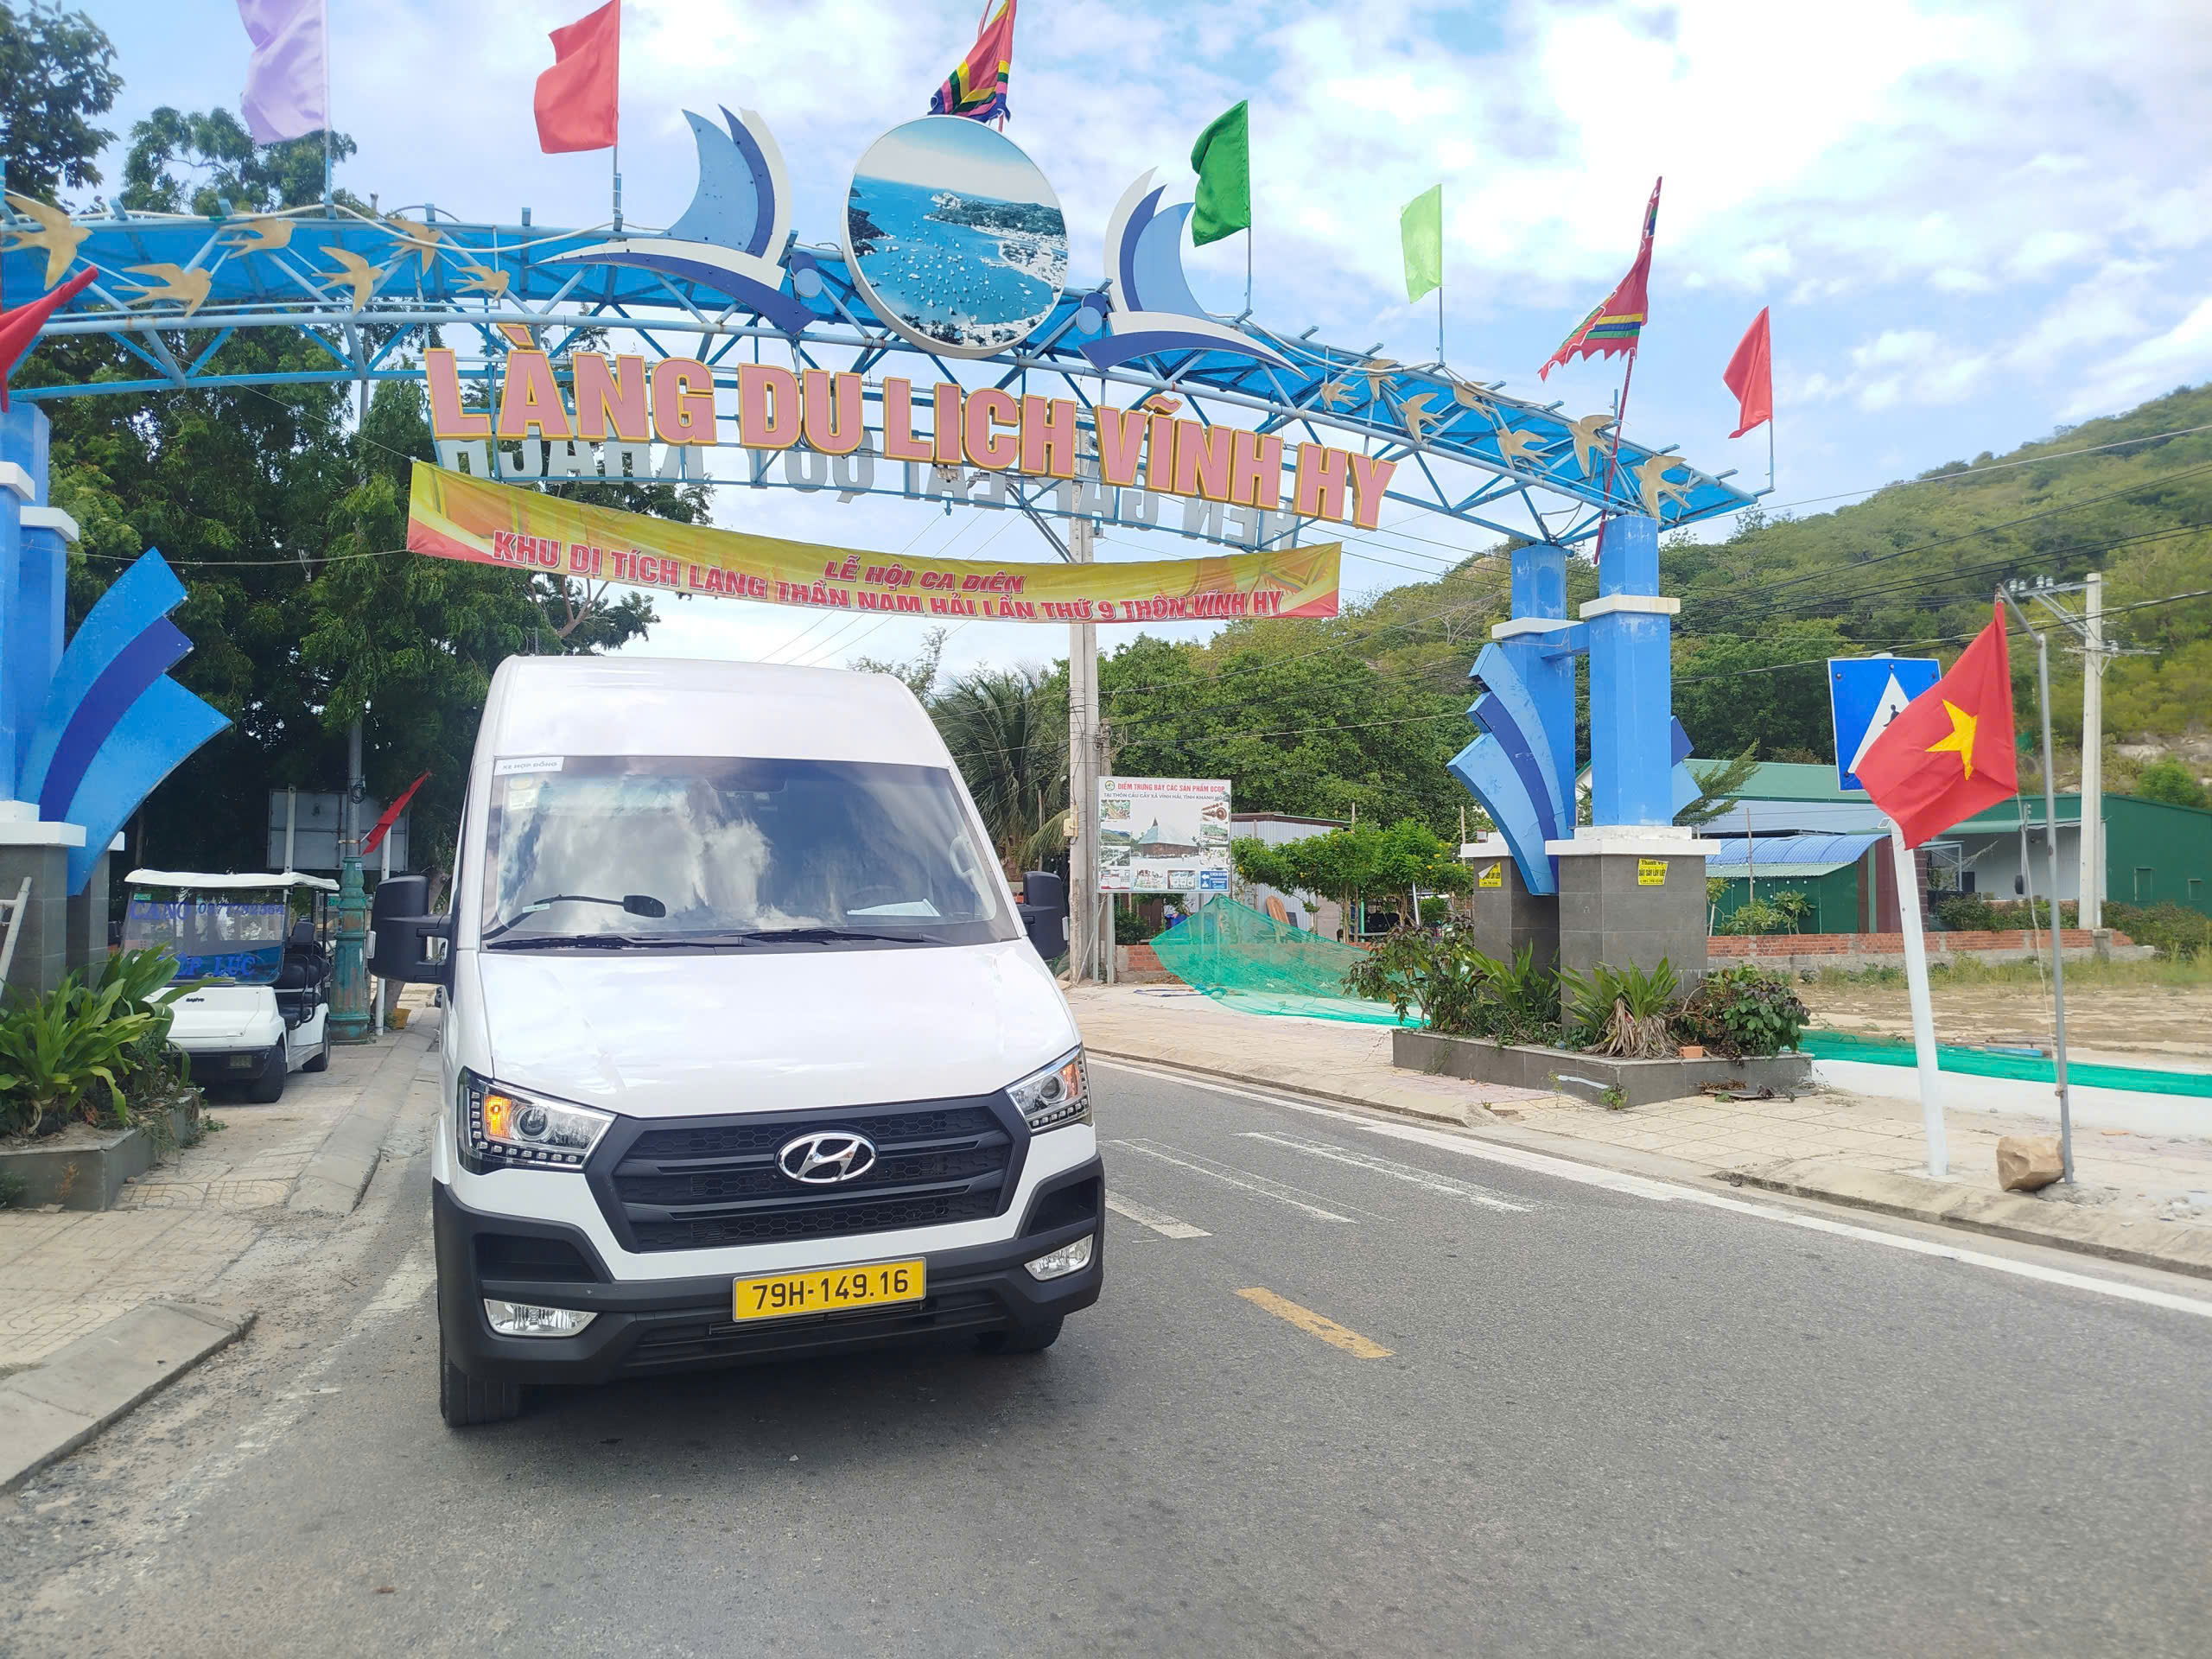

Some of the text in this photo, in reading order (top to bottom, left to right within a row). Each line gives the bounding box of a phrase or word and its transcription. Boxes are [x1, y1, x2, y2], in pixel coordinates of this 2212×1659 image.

[423, 322, 717, 446] LÀNG
[738, 363, 863, 455] DU
[1093, 394, 1283, 510] VĨNH
[1296, 442, 1398, 530] HY
[493, 531, 560, 569] KHU
[569, 543, 601, 575] DI
[611, 549, 680, 587] TÍCH
[774, 580, 851, 608] THẦN
[856, 591, 925, 613] NAM
[930, 592, 976, 616] HẢI
[982, 594, 1037, 619] LẦN
[1040, 598, 1093, 620] THỨ
[1099, 601, 1116, 620] 9
[1121, 594, 1188, 620] THÔN
[1192, 589, 1248, 617] VĨNH
[1253, 590, 1283, 616] HY
[824, 555, 860, 582] LỄ
[864, 563, 914, 590] HỘI
[919, 571, 955, 590] CA
[752, 1268, 908, 1310] 79H-149.16
